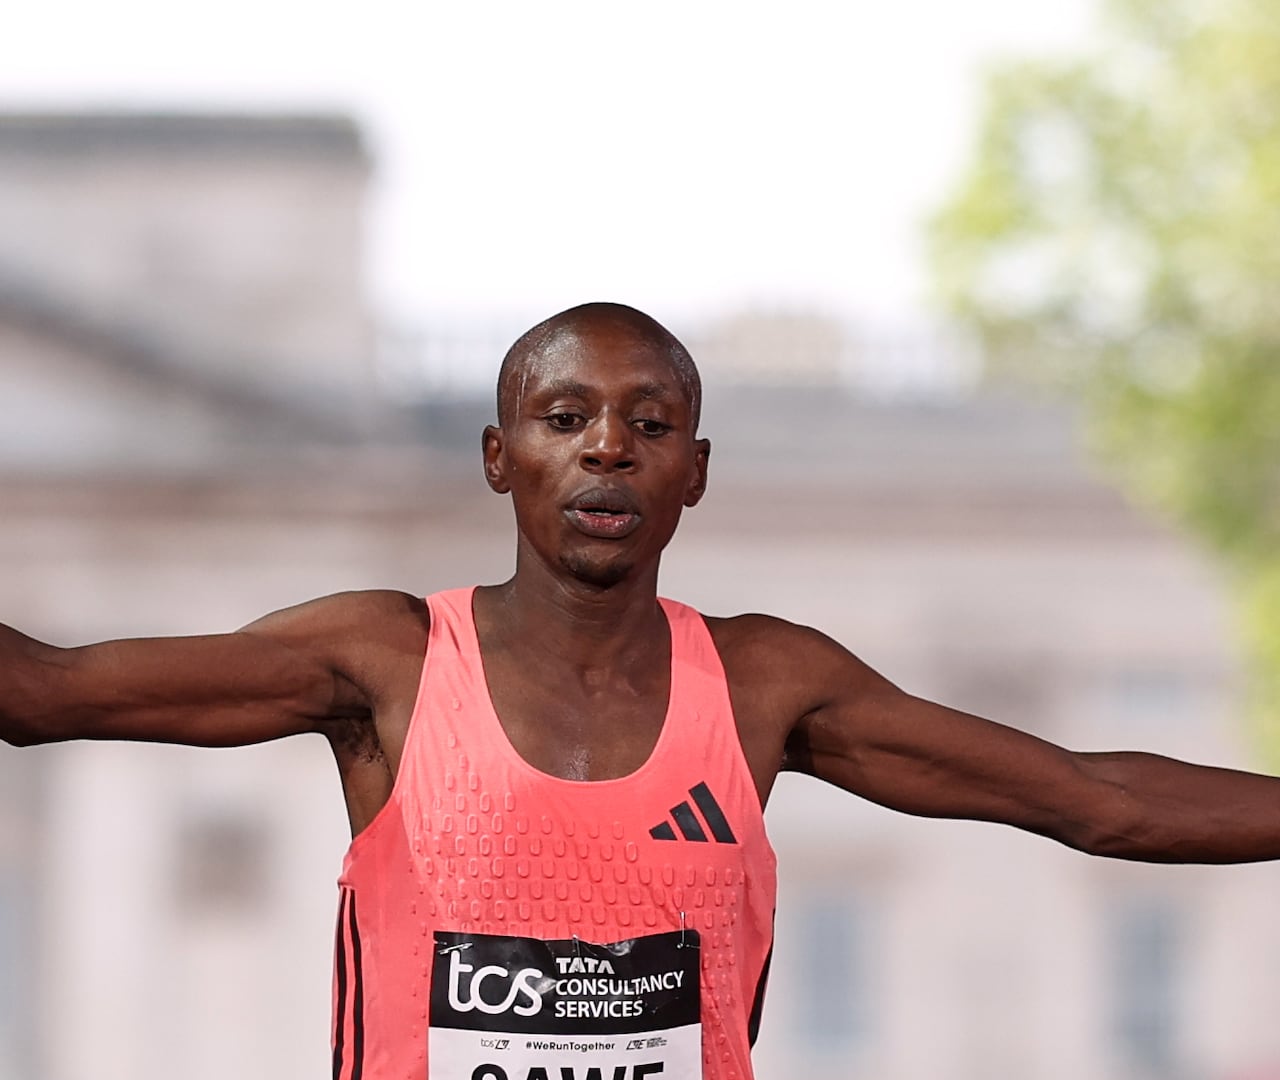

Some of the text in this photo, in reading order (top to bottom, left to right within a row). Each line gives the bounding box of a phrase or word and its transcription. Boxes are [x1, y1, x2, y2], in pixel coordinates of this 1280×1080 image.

[555, 957, 615, 974] TATA
[447, 950, 543, 1016] tcs
[555, 970, 685, 996] CONSULTANCY
[554, 1000, 643, 1018] SERVICES
[526, 1041, 616, 1053] #WeRunTogether
